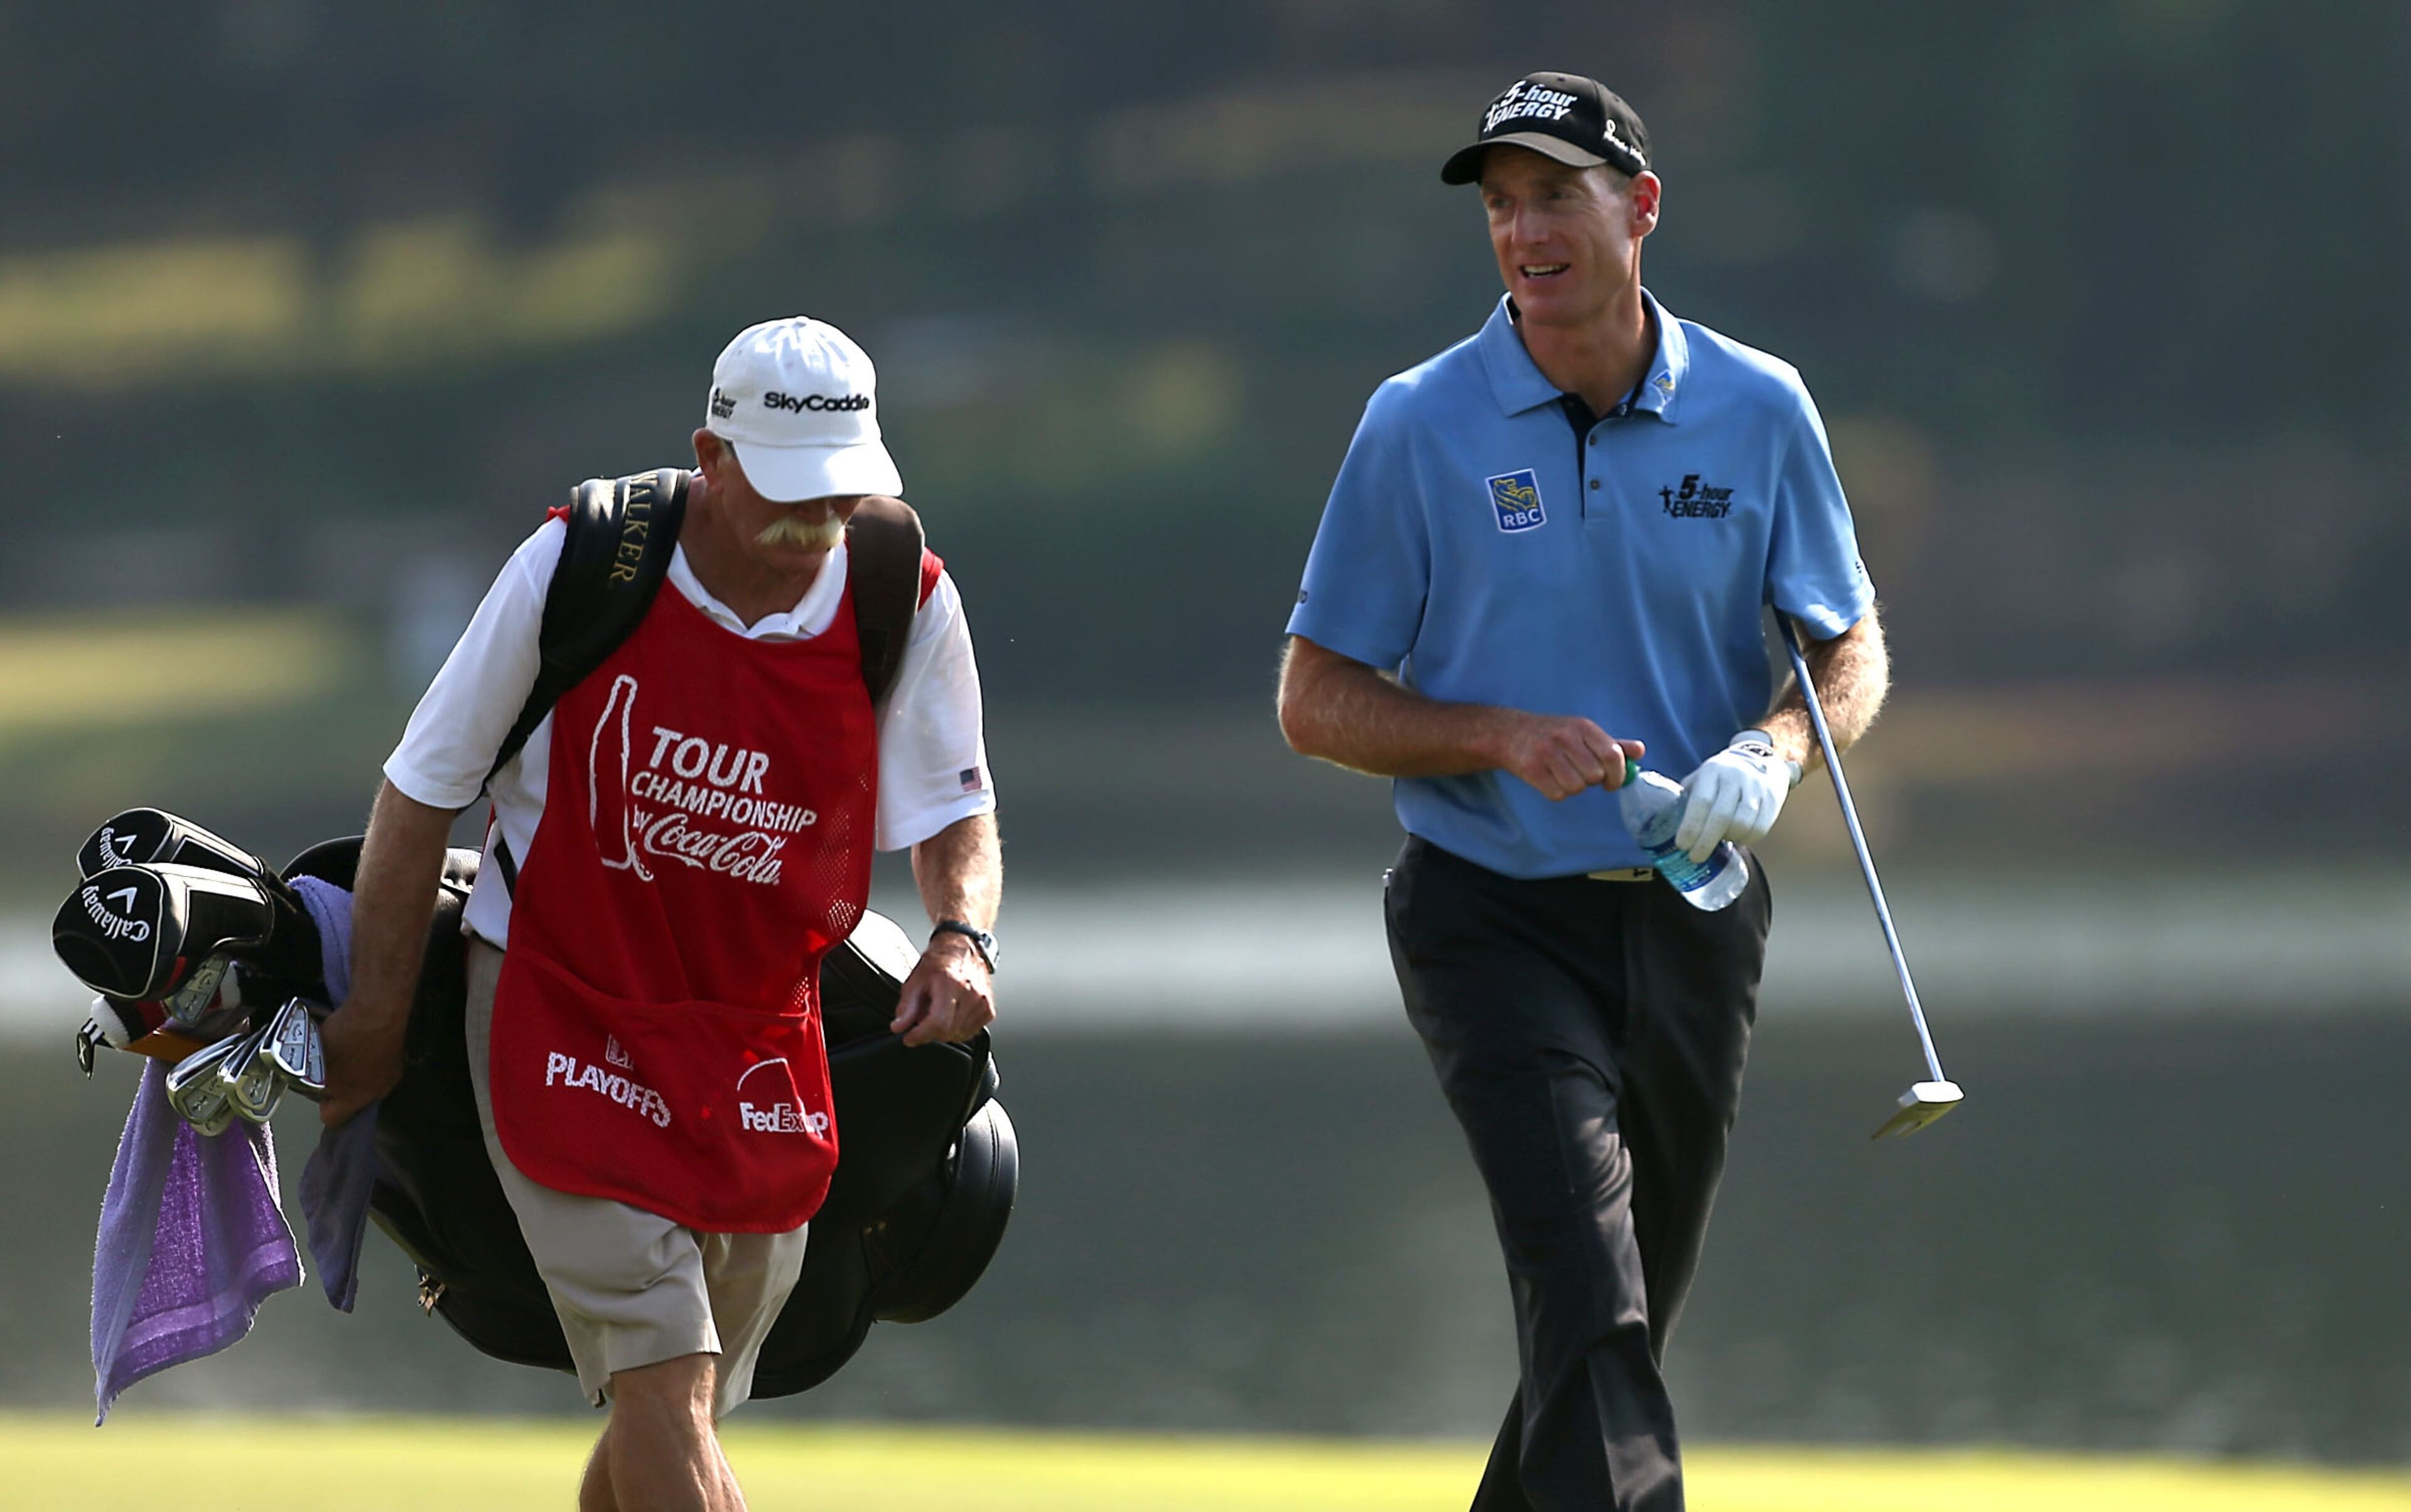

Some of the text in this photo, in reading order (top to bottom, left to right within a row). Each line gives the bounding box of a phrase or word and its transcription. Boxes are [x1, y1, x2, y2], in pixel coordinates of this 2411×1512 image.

[1500, 80, 1578, 107] 5-hour
[1493, 101, 1572, 126] ENERGY
[1677, 473, 1735, 500] 5-hour
[1502, 507, 1541, 528] RBC
[1670, 501, 1732, 519] ENERGY
[649, 726, 770, 794] TOUR
[631, 771, 817, 833] CHAMPIONSHIP
[82, 884, 151, 942] Callaway
[546, 1052, 671, 1128] PLAYOFFS
[739, 1101, 829, 1140] FedExp
